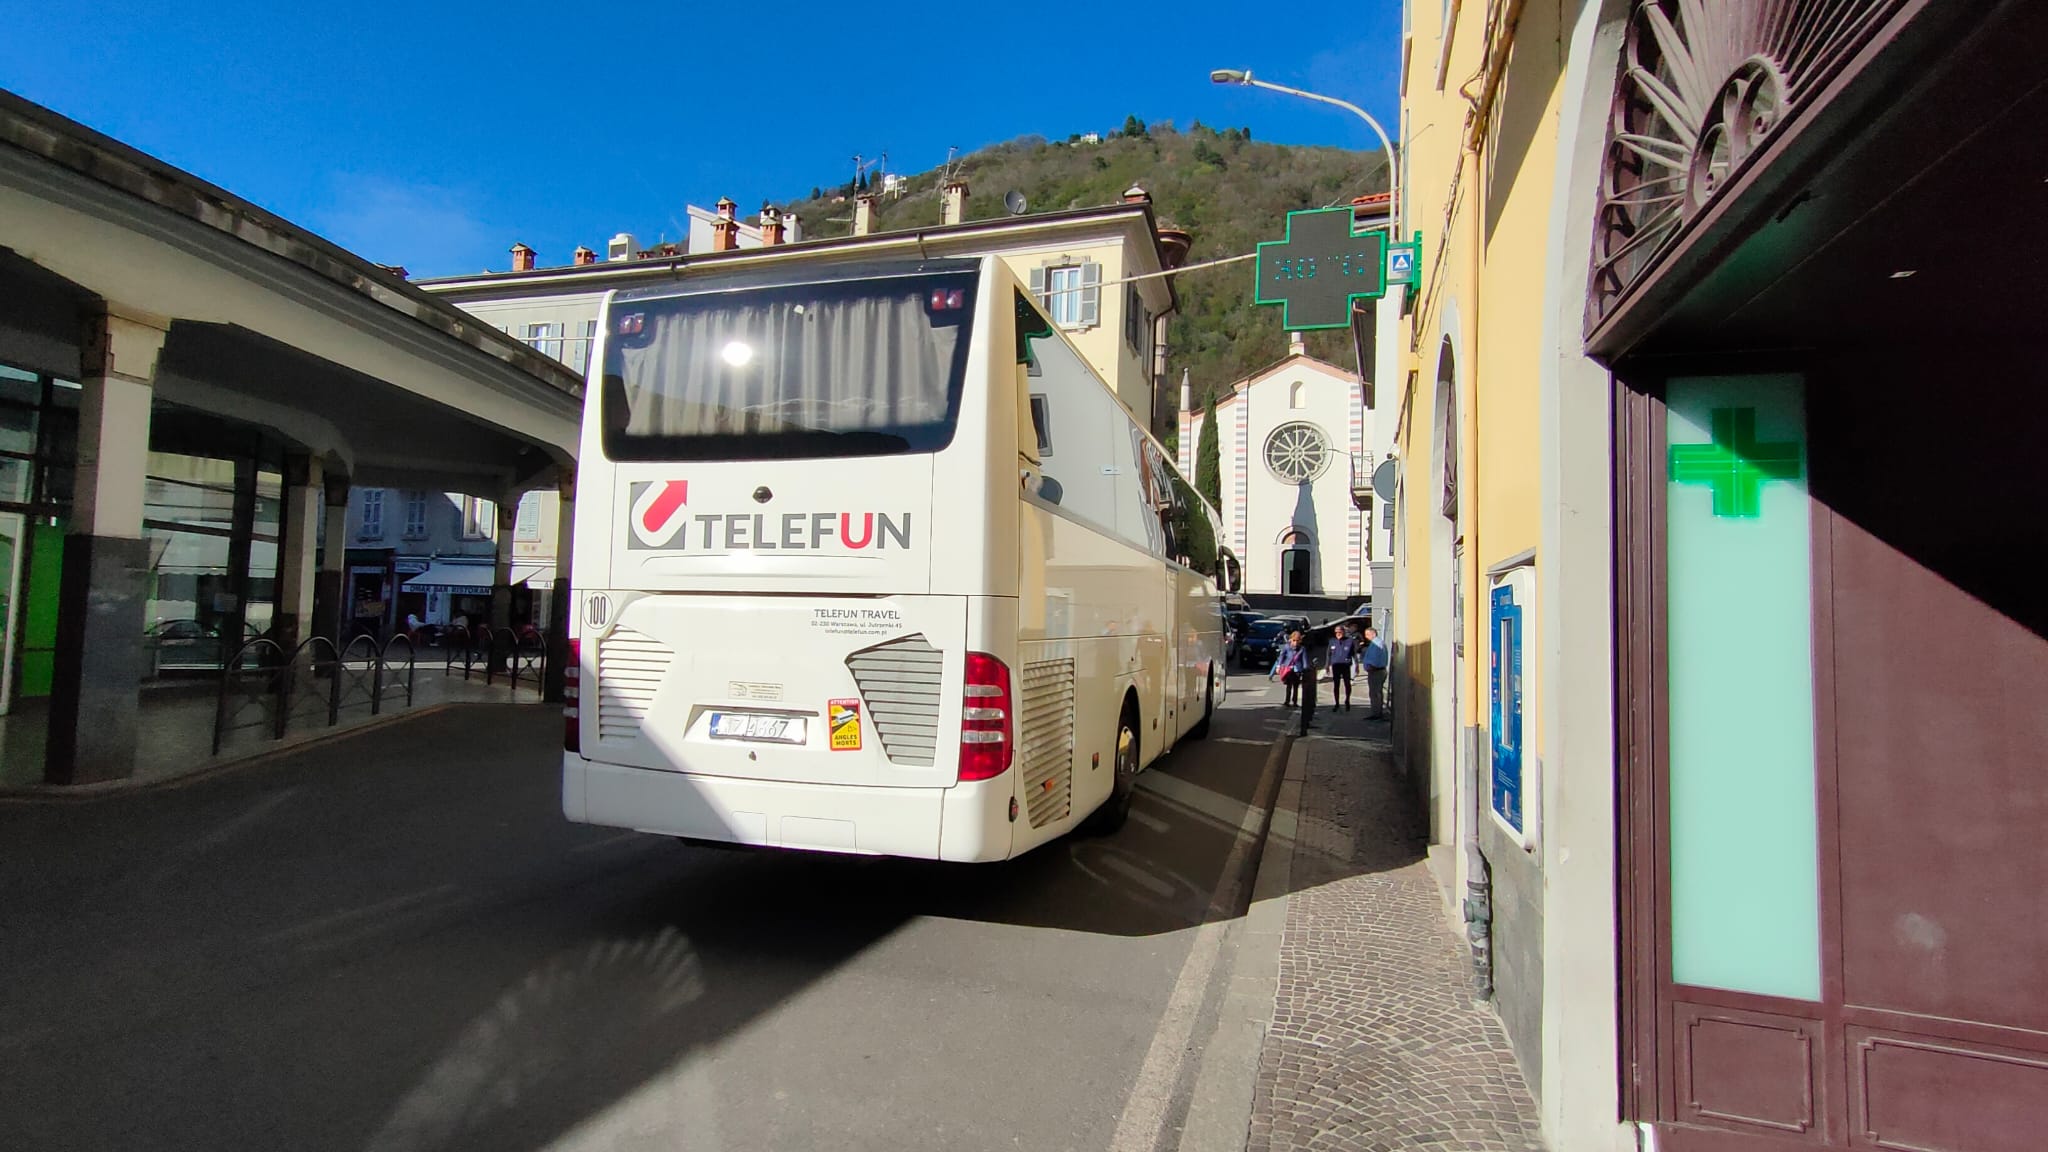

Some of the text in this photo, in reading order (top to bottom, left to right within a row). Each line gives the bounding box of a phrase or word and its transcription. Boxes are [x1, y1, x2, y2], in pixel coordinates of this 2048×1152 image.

[695, 512, 912, 549] TELEFUN
[589, 596, 606, 625] 100
[814, 609, 901, 620] TELEFUN TRAVEL
